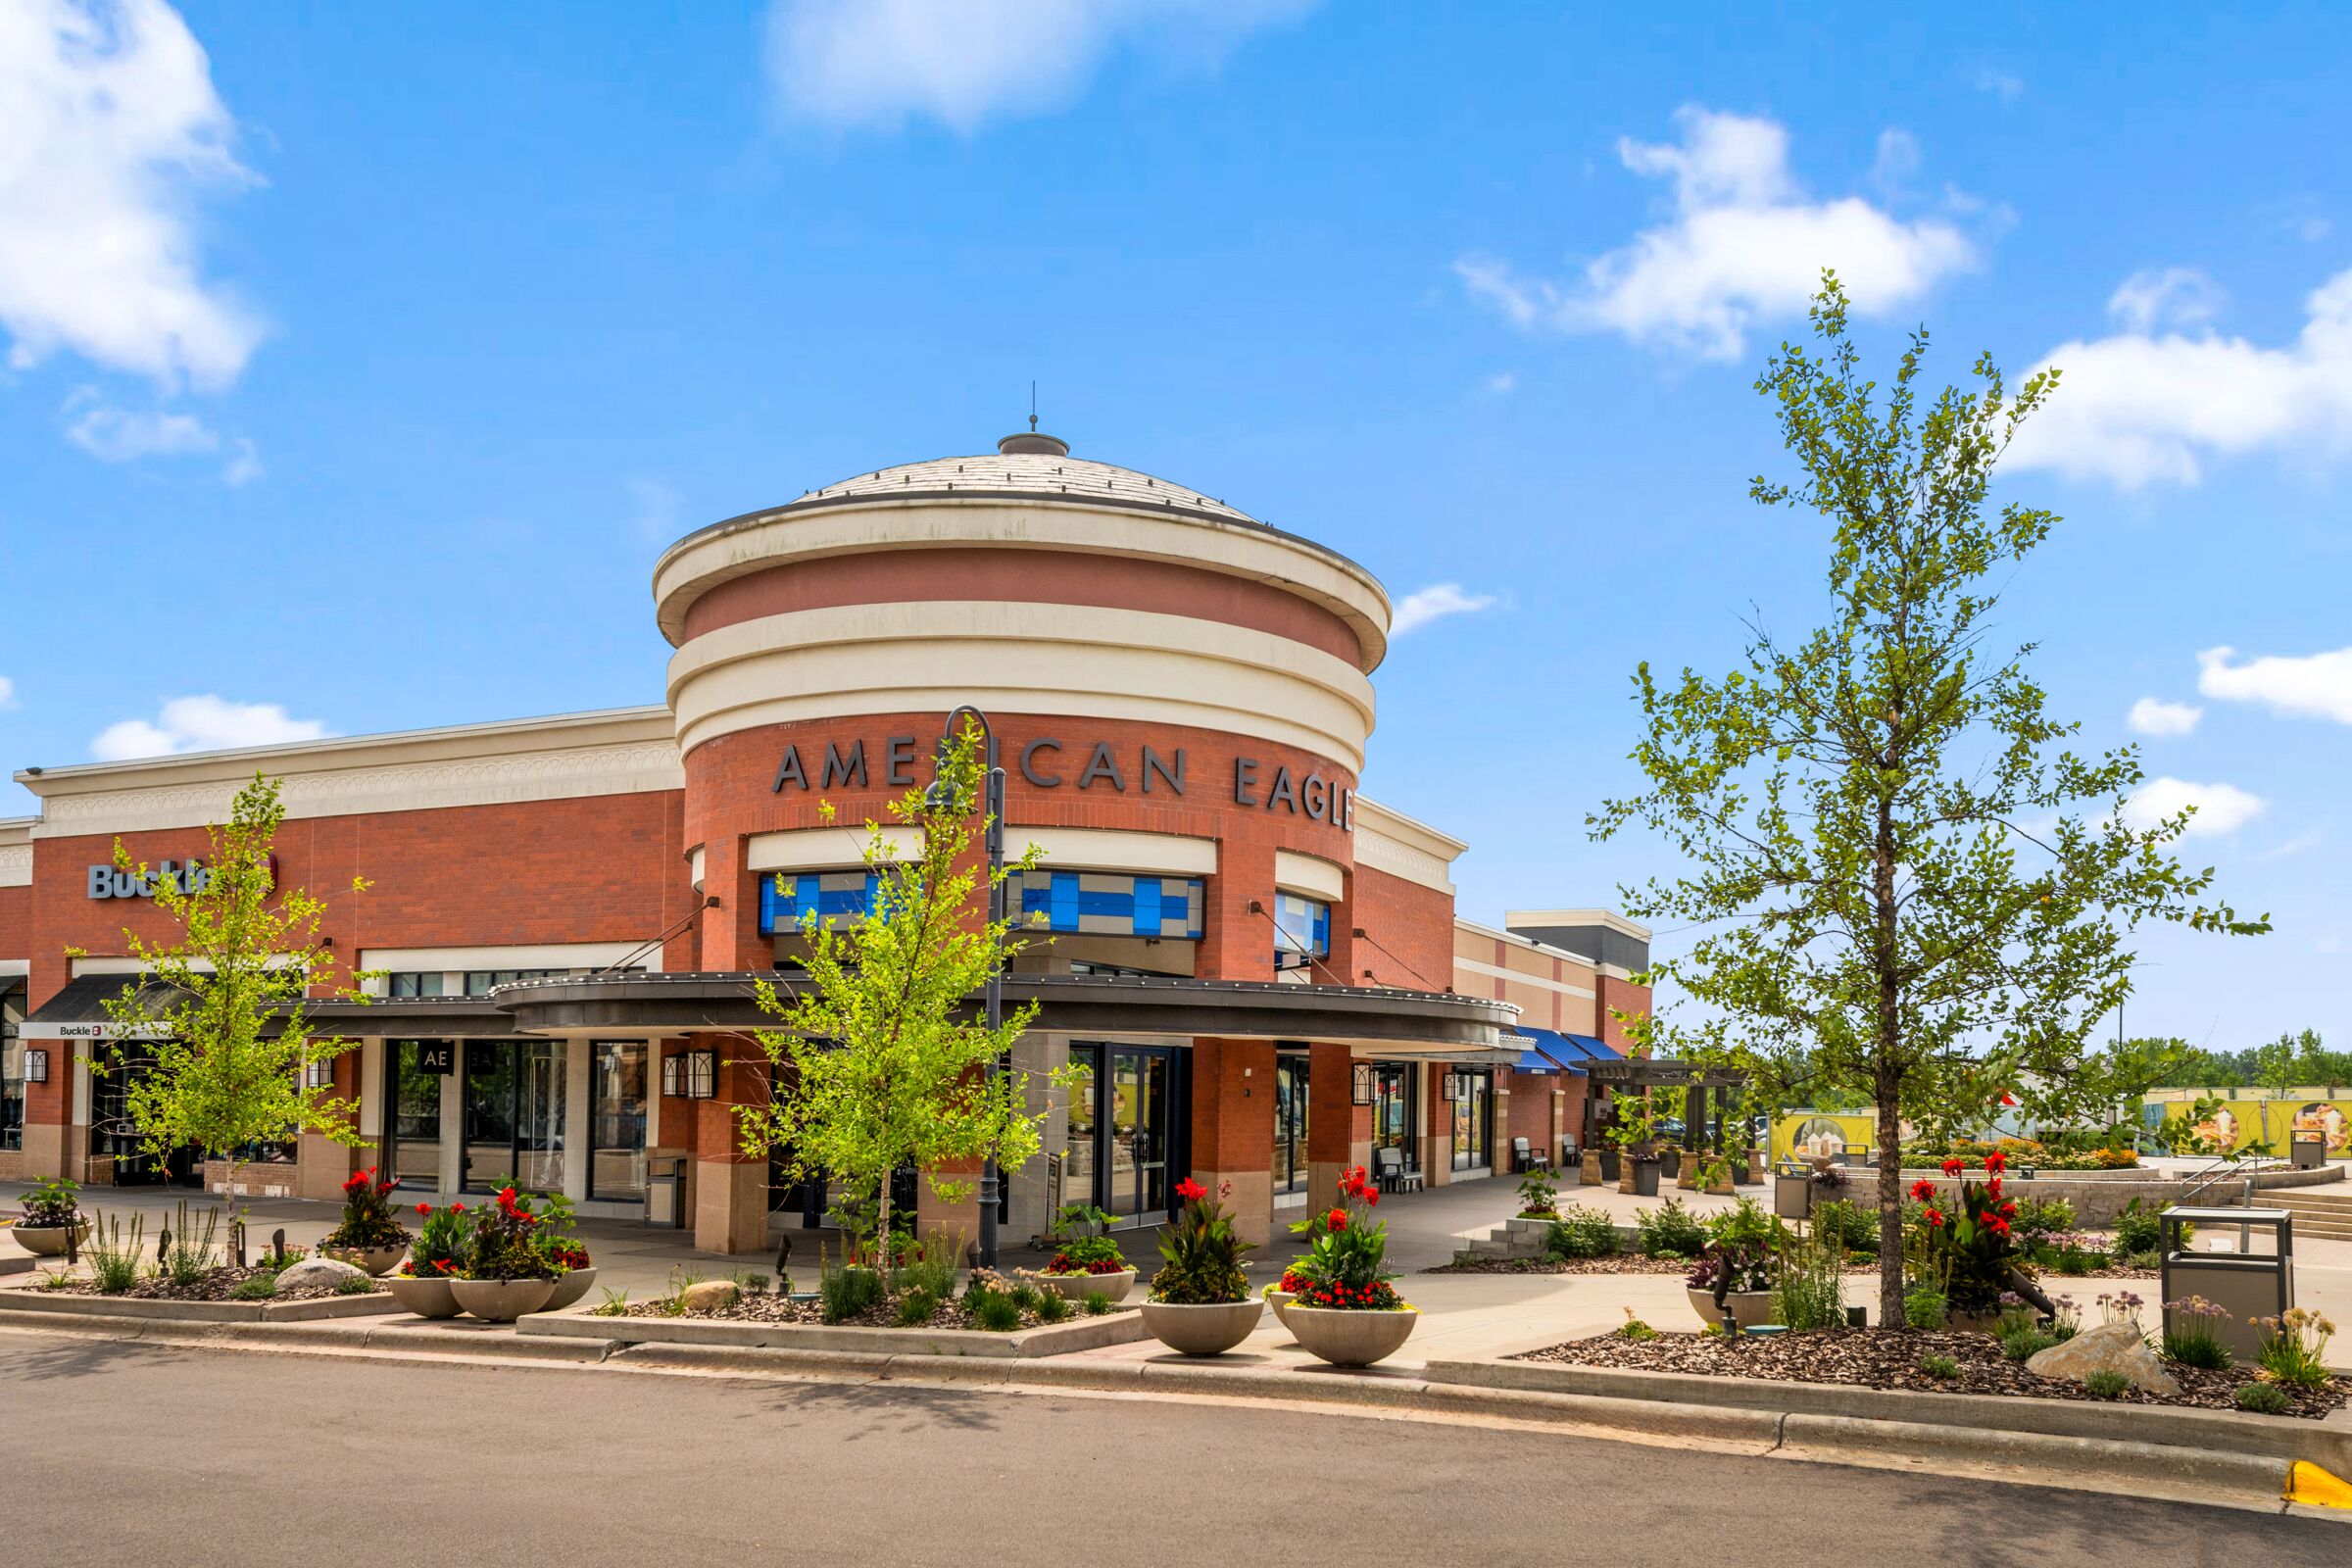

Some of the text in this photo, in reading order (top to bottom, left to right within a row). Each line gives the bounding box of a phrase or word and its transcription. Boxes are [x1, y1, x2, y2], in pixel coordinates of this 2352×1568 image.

[772, 736, 1352, 832] AMEICAN EAGLE
[60, 1026, 91, 1036] Buckle
[424, 1051, 448, 1066] AE
